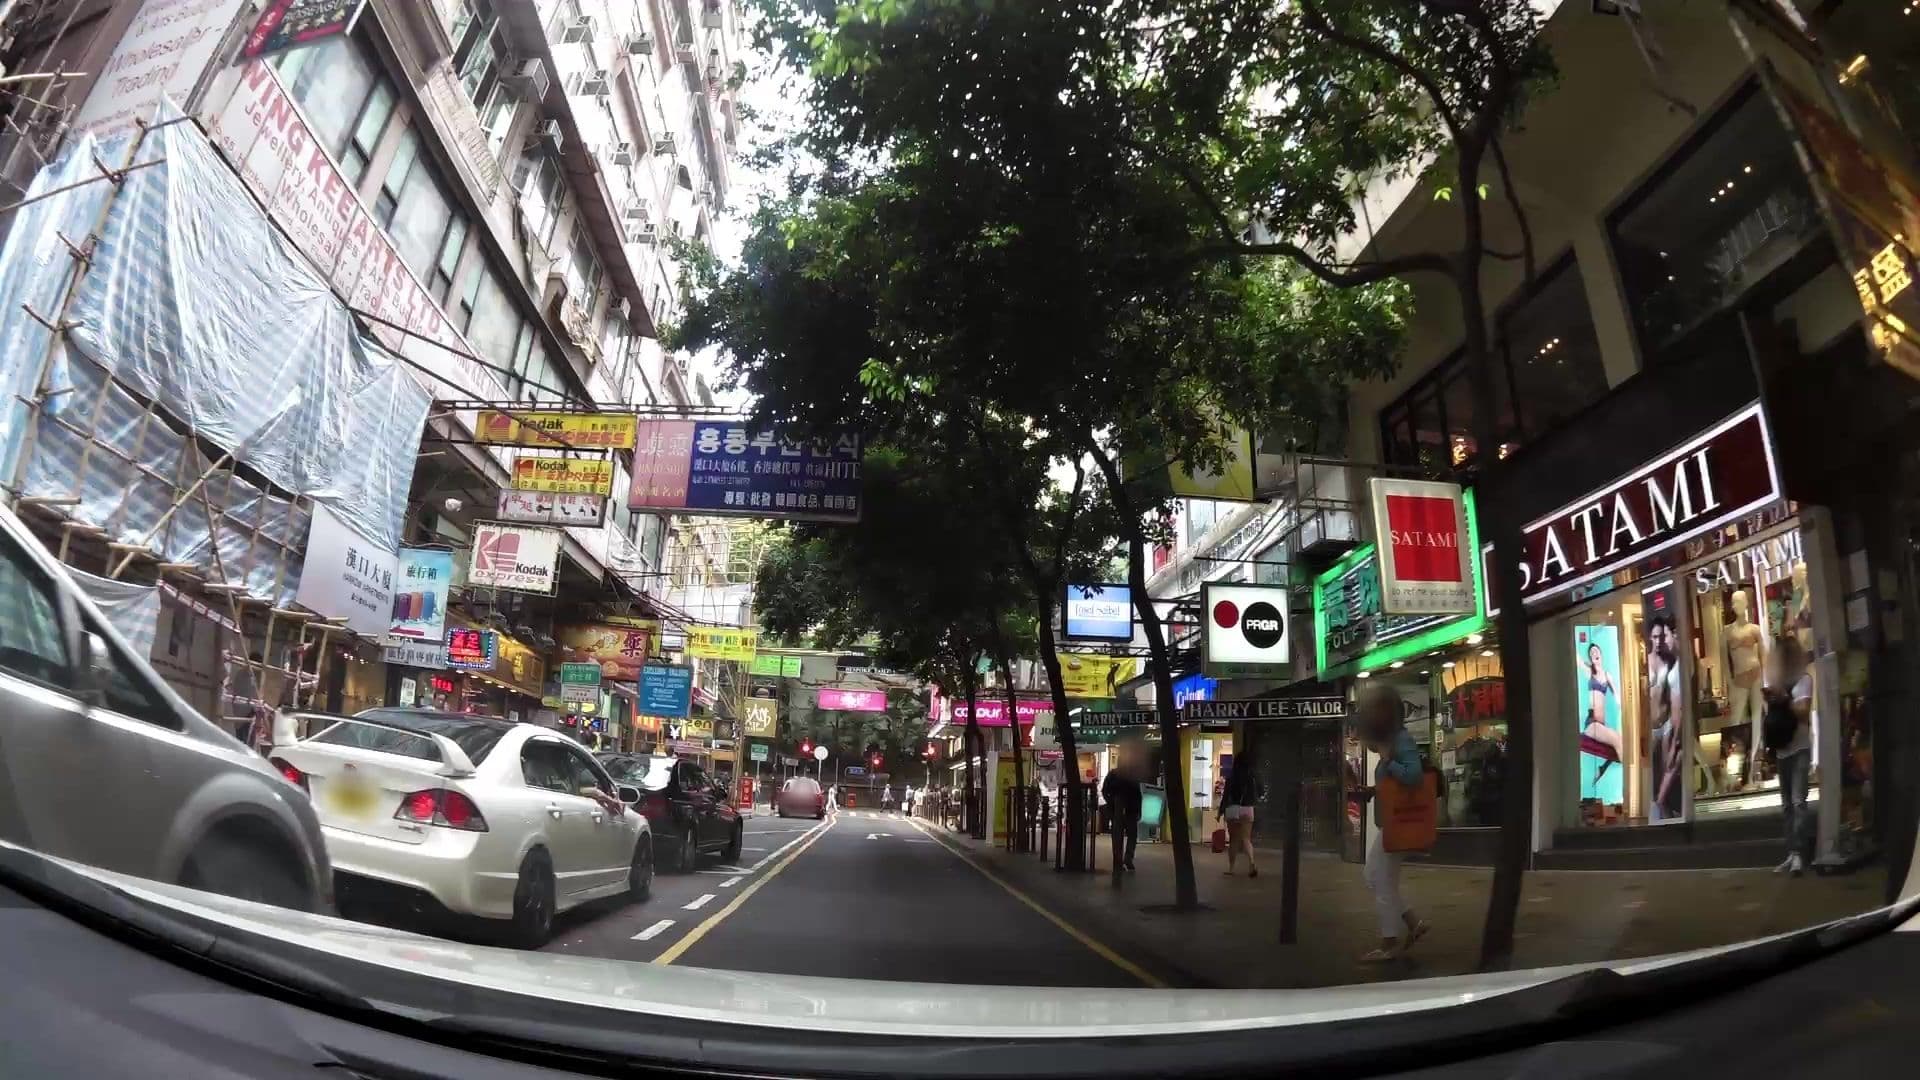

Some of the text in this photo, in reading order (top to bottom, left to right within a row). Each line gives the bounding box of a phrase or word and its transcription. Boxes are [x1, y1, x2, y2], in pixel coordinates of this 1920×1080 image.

[242, 58, 307, 157] WING
[307, 147, 355, 221] KEE
[353, 216, 407, 290] ARTS
[518, 417, 564, 431] Kodak
[535, 459, 570, 471] Kodak
[546, 471, 610, 484] EXPRESS
[1390, 530, 1458, 548] SATAMI
[515, 563, 549, 577] Kodak
[1695, 531, 1803, 595] SATAMI
[475, 570, 546, 585] express
[1246, 619, 1279, 631] PRGR
[1190, 702, 1250, 718] HARRY
[1258, 701, 1289, 717] LEE
[1083, 712, 1149, 725] HARRY LEE
